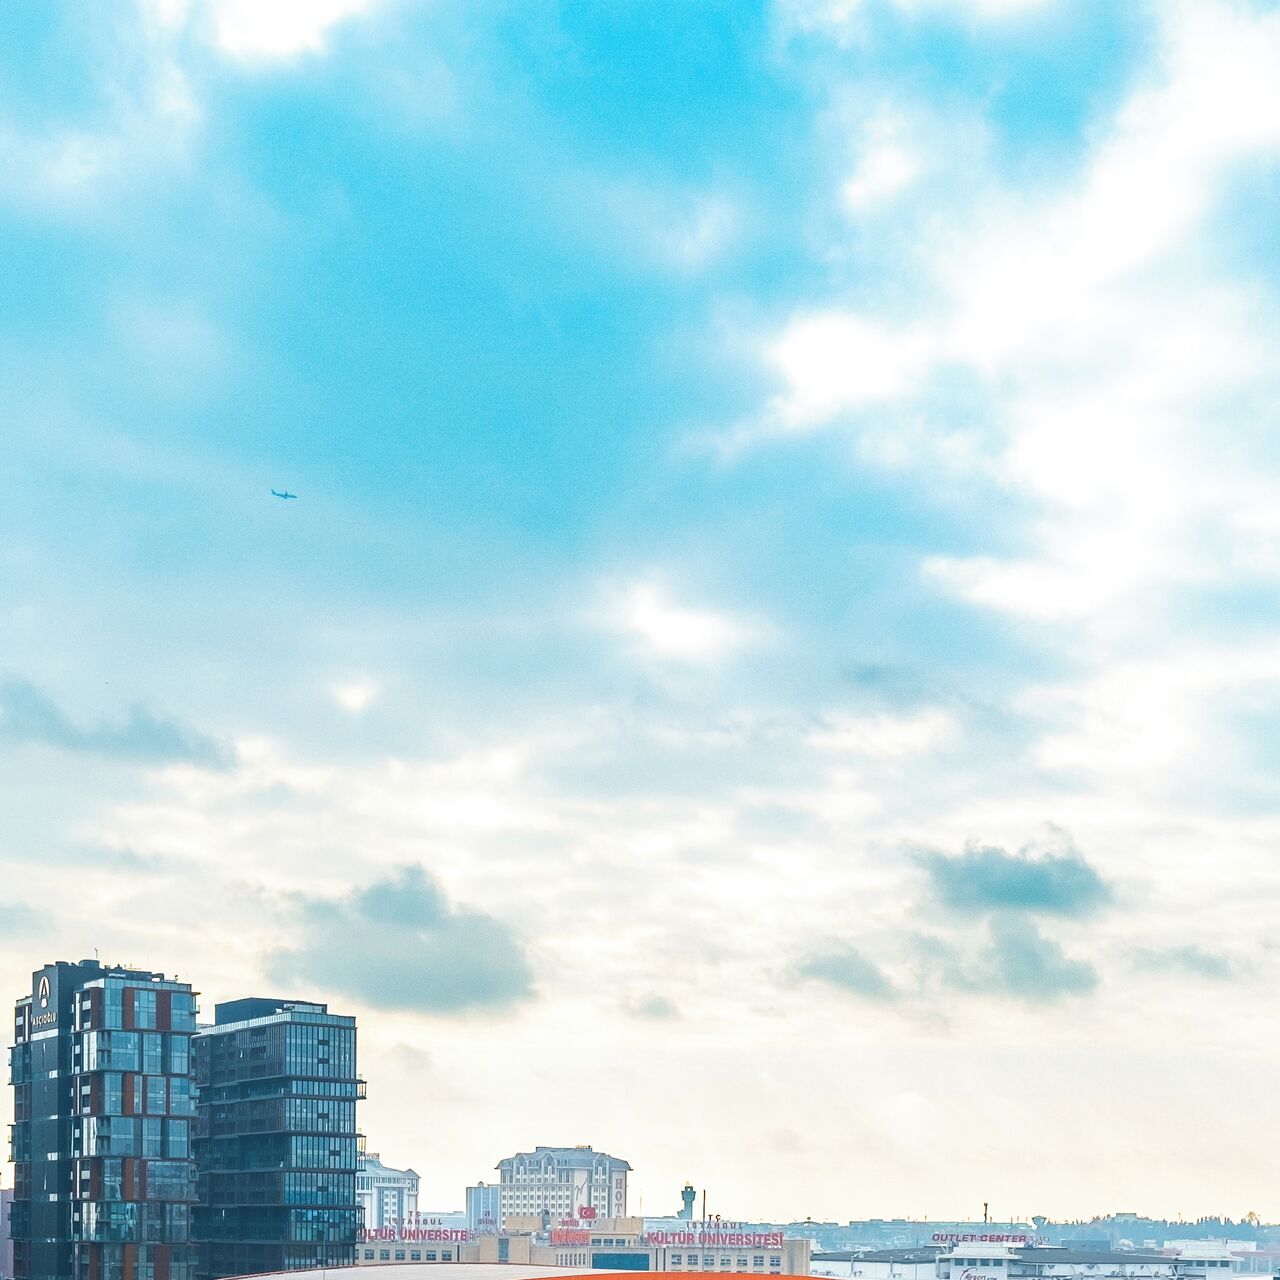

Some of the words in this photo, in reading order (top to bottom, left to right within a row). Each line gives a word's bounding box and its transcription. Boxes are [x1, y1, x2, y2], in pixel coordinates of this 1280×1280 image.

[647, 1231, 695, 1245] KÜLTÜR
[932, 1233, 977, 1242] OUTLET
[980, 1234, 1026, 1242] CENTER
